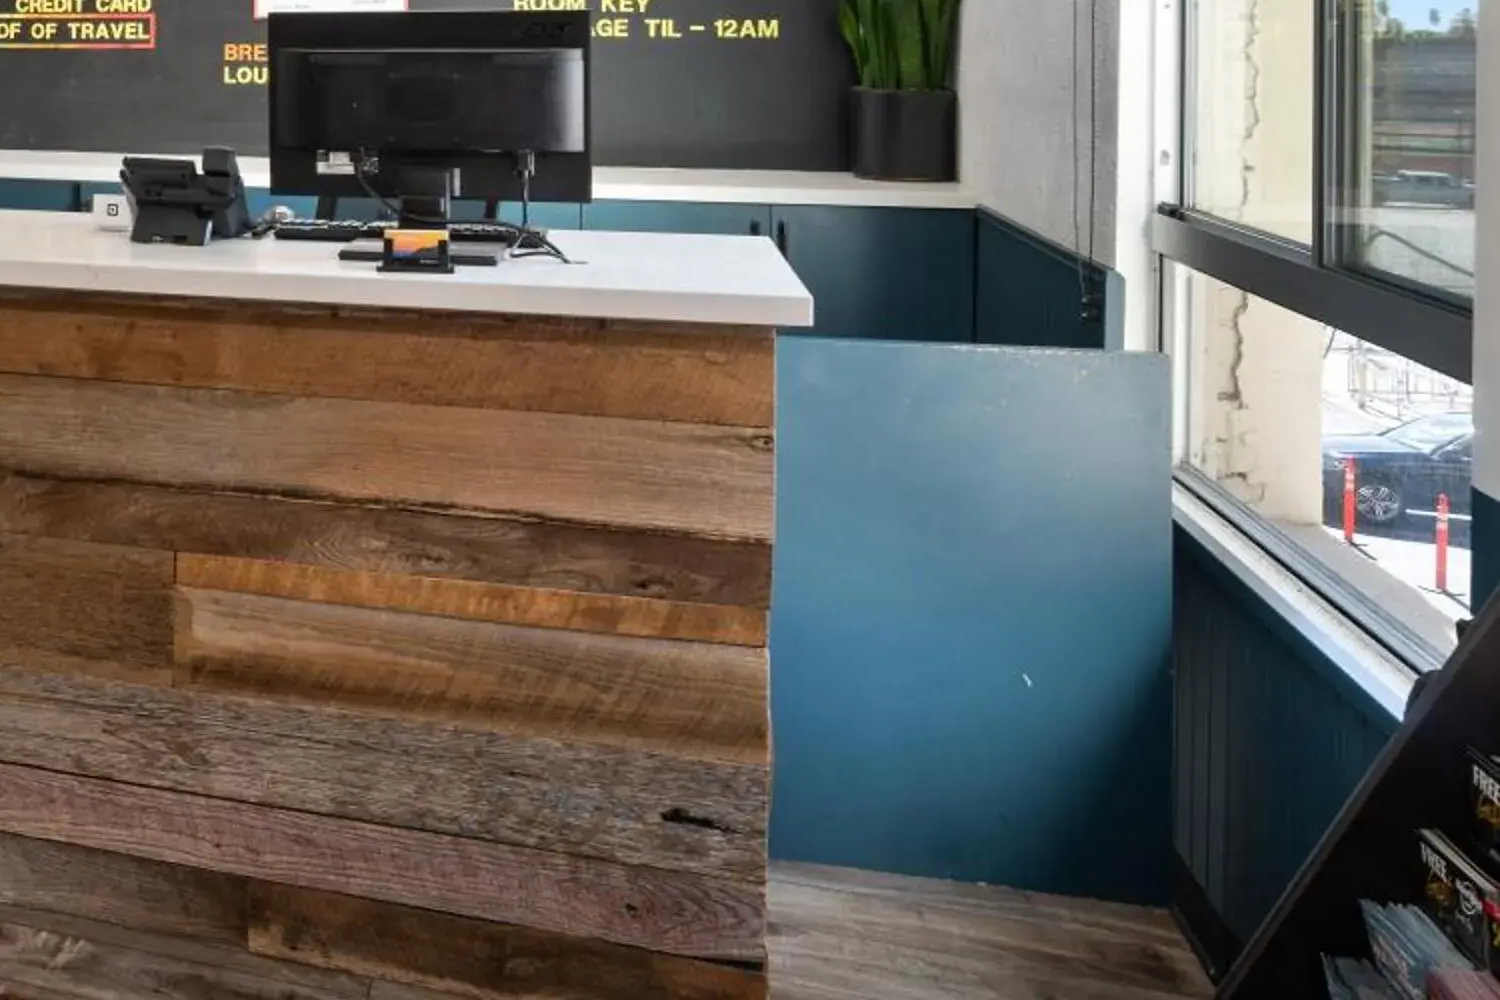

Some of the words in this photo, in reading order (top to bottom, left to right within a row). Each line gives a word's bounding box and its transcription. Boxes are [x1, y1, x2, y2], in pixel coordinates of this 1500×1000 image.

[30, 21, 57, 40] OF
[68, 21, 151, 40] TRAVEL
[643, 18, 683, 38] TIL
[713, 18, 780, 39] 12AM
[223, 43, 268, 62] BRE
[223, 66, 269, 86] LOU
